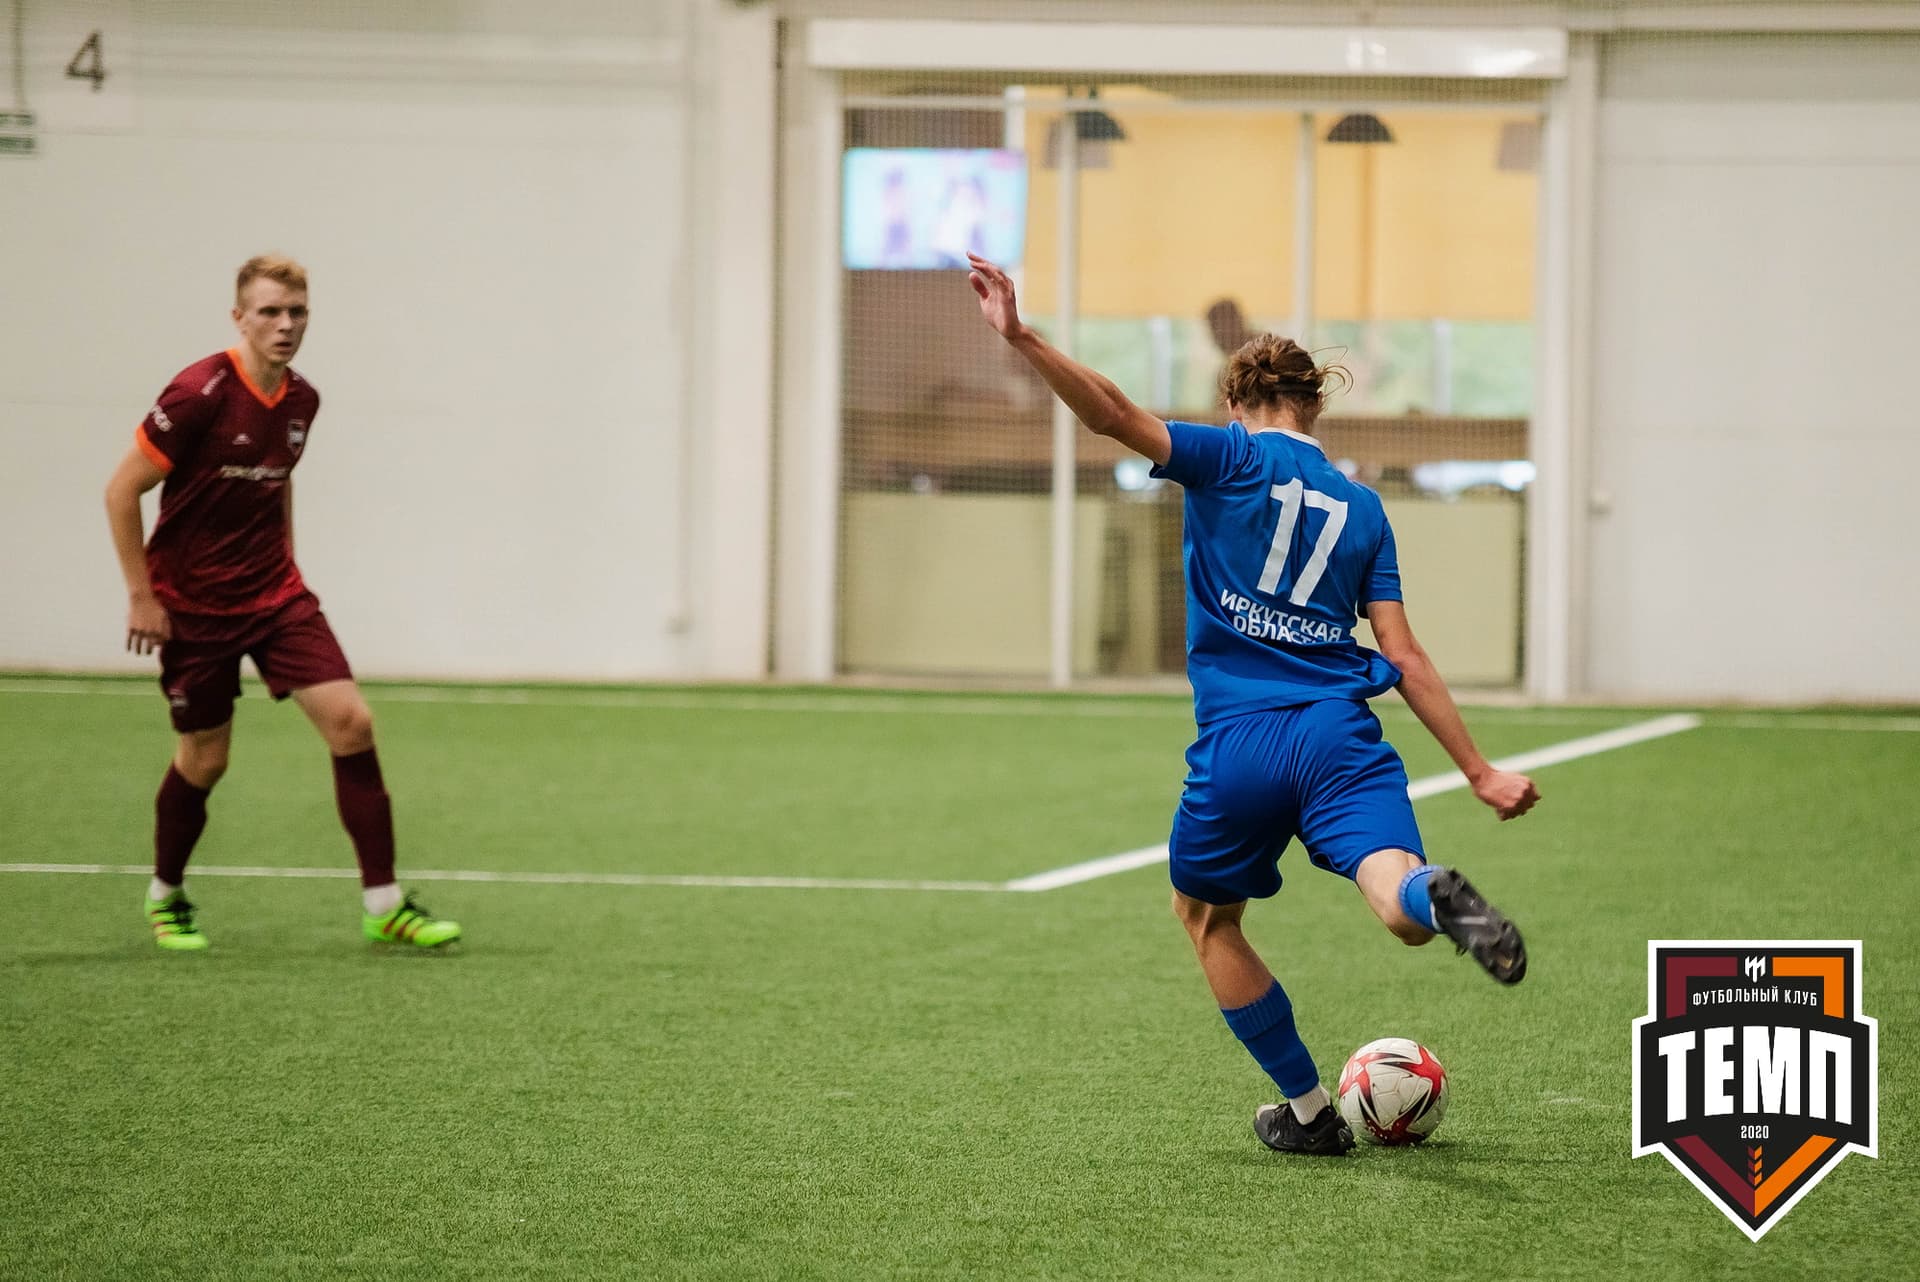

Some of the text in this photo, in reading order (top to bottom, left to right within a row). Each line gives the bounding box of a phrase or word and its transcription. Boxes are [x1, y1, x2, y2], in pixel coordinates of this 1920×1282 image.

[65, 29, 108, 92] 4
[1256, 476, 1349, 608] 17
[1220, 588, 1343, 643] ИРКУТСКАЯ
